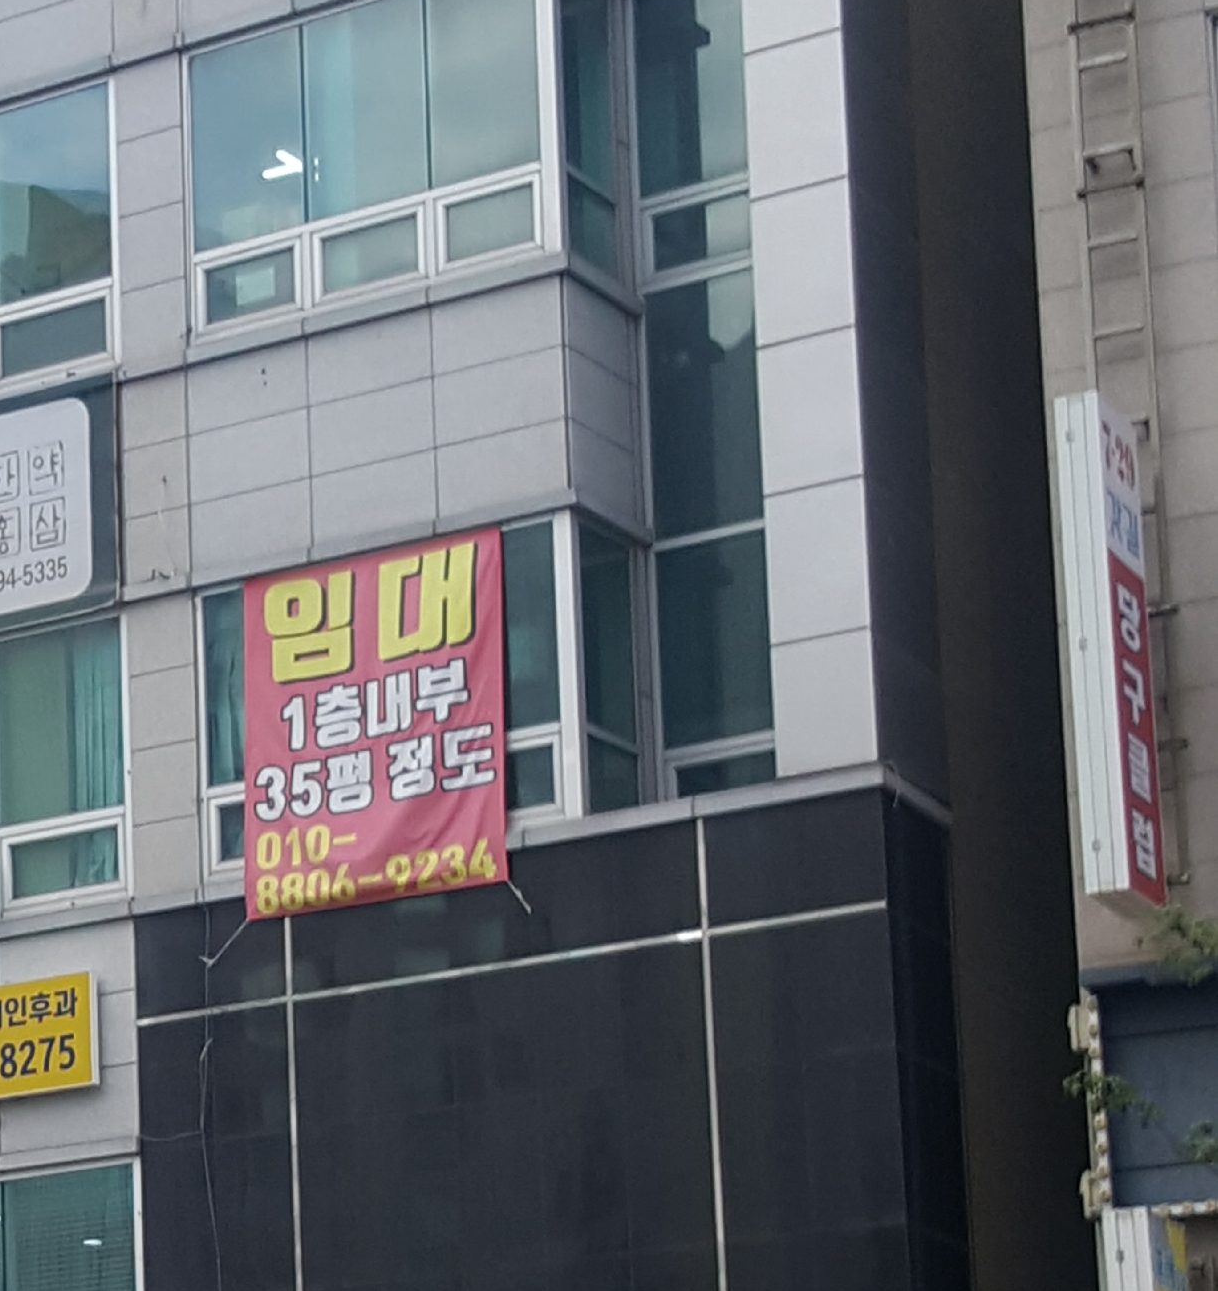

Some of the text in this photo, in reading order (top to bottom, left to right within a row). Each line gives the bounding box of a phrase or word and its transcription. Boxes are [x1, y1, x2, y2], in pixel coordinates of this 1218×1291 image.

[282, 659, 469, 751] 1층내부
[255, 723, 496, 821] 35평 정도
[256, 825, 357, 870] 010-
[256, 838, 498, 915] 8806-9234
